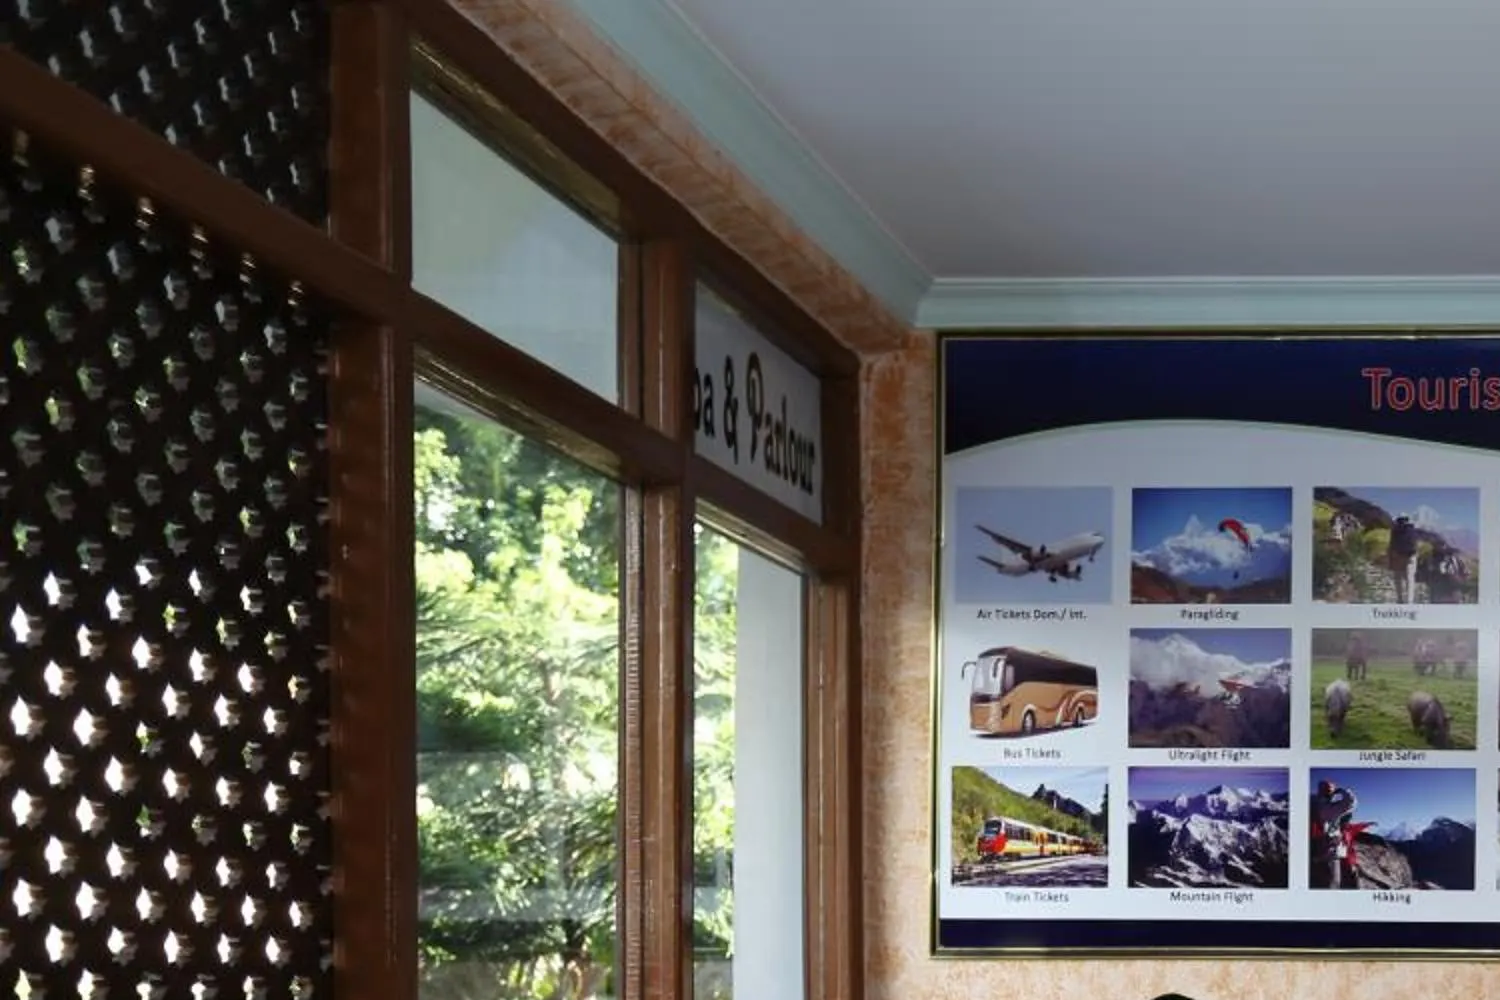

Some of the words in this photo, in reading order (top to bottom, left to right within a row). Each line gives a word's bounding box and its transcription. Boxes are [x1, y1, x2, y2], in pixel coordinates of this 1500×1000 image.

[723, 354, 739, 466] &
[746, 351, 815, 497] Parlour
[976, 608, 993, 620] Air
[995, 608, 1031, 620] Tickets
[1180, 608, 1239, 622] Paragliding
[1372, 607, 1417, 621] Trekking
[1003, 747, 1023, 759] Bus
[1025, 747, 1061, 759] Tickets
[1168, 748, 1218, 762] Ultralight
[1221, 748, 1251, 762] Flight
[1359, 750, 1393, 763] Jungle
[1394, 750, 1427, 762] Safari
[1004, 891, 1031, 902] Train
[1034, 891, 1069, 902] Tickets
[1170, 890, 1221, 903] Mountain
[1224, 890, 1254, 905] Flight
